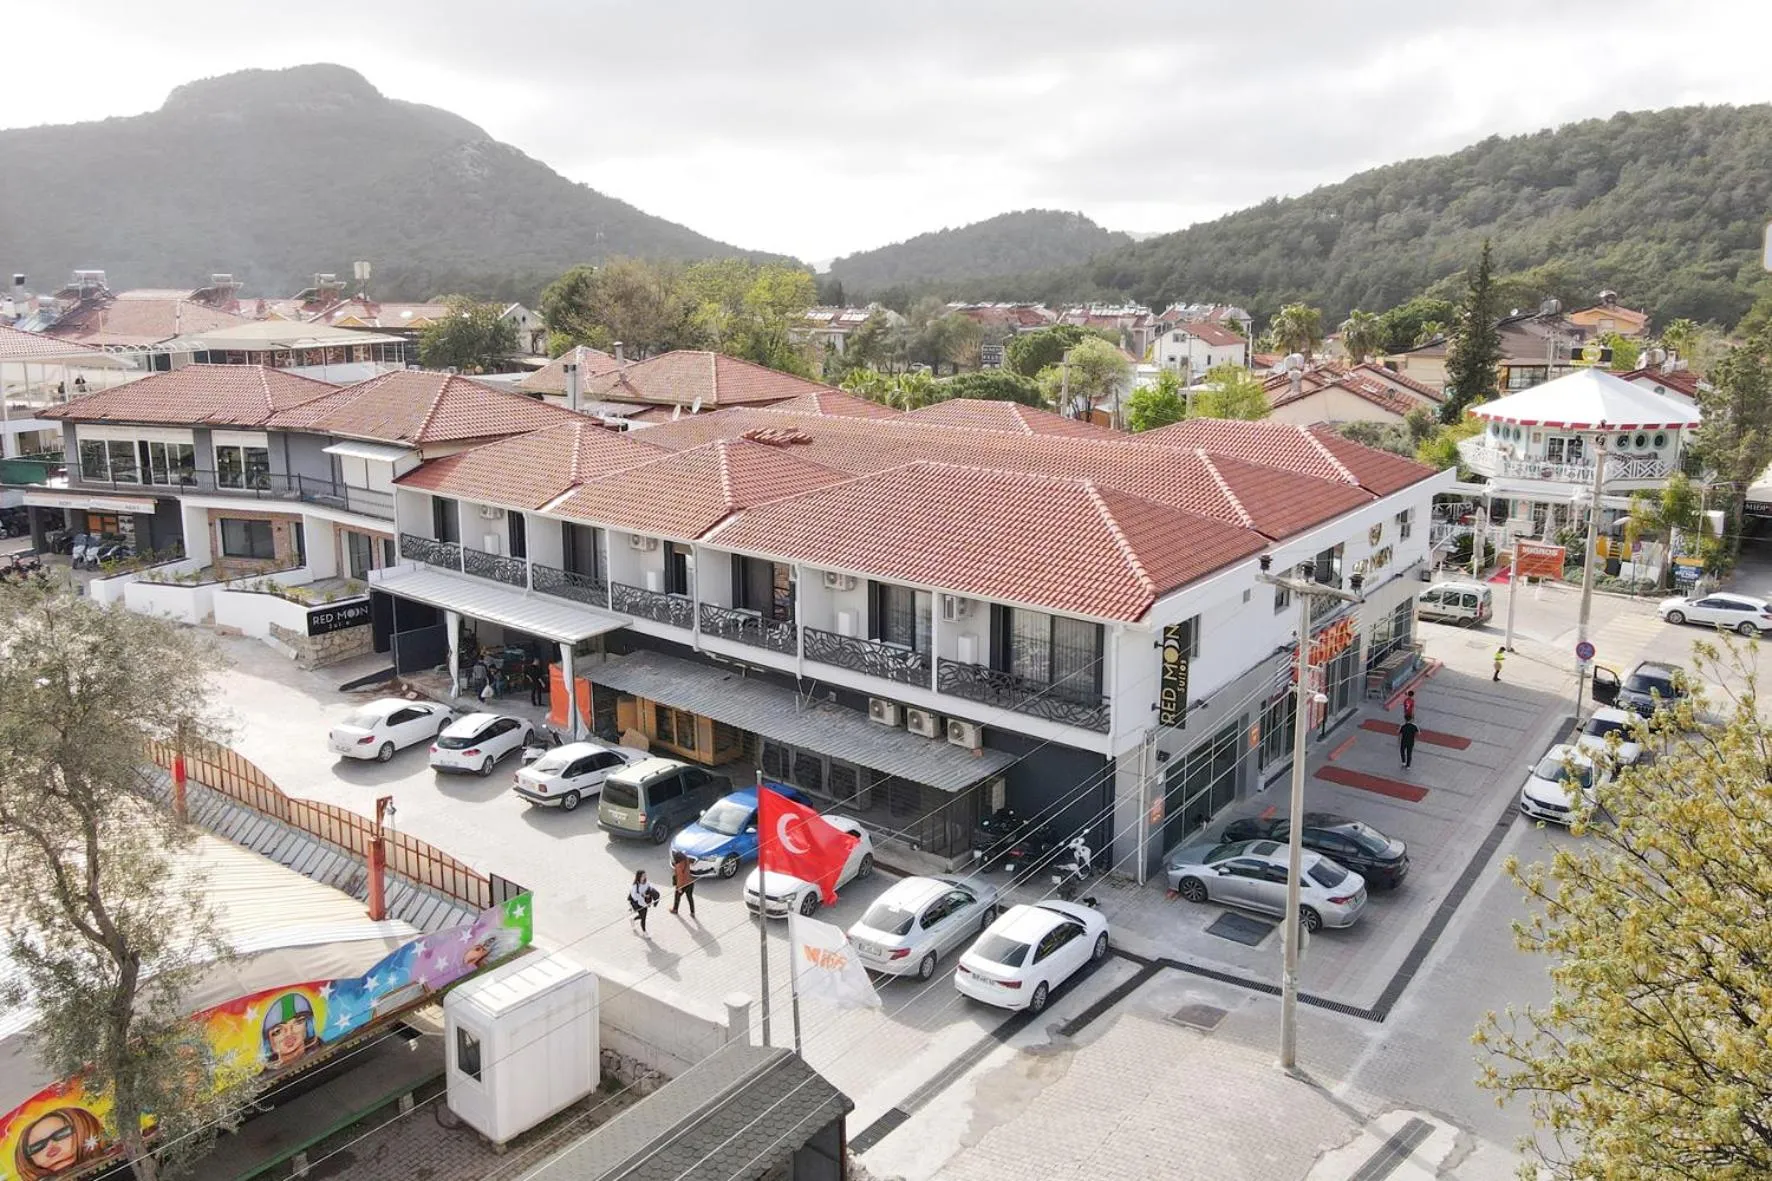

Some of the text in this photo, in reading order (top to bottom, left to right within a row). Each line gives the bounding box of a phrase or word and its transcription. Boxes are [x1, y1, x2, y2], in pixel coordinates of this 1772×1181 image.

[312, 613, 334, 626] RED
[337, 605, 369, 621] MOON
[1160, 624, 1180, 725] RED MOON
